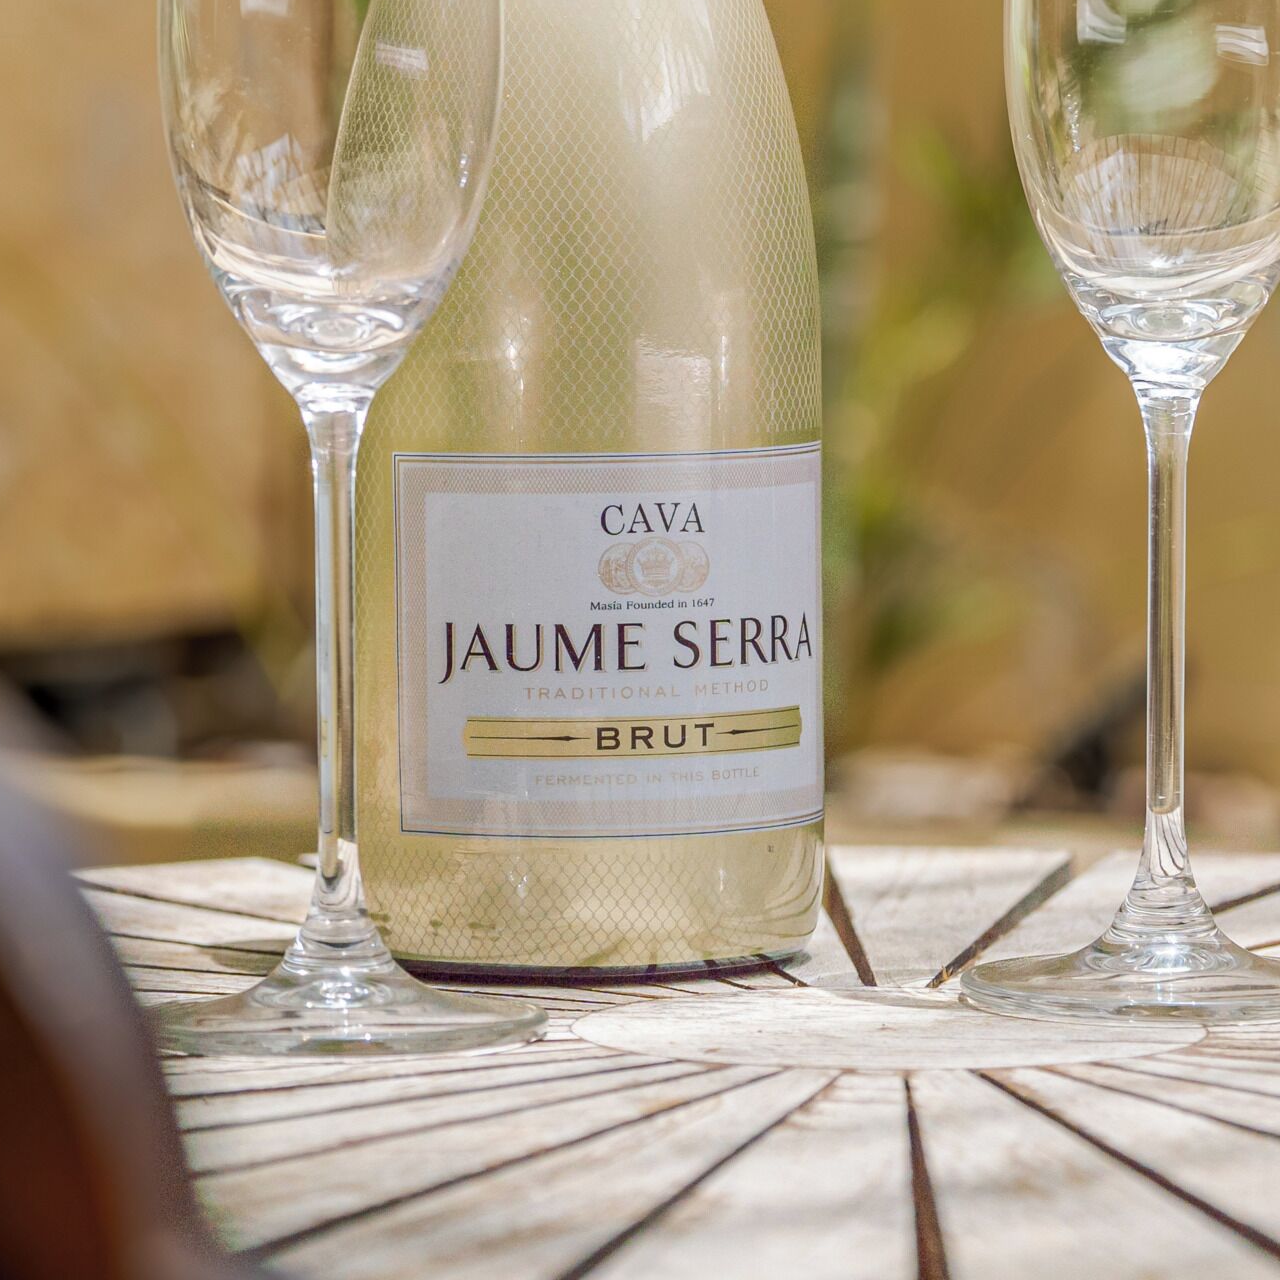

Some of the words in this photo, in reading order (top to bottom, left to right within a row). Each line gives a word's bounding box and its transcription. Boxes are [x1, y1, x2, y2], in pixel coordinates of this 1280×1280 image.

[600, 502, 706, 536] CAVA
[626, 599, 675, 610] Founded
[677, 599, 688, 609] in
[691, 597, 715, 608] 1647
[437, 621, 648, 685] JAUME
[672, 611, 813, 670] SERRA
[523, 685, 681, 701] TRADITIONAL
[694, 679, 769, 697] METHOD
[596, 722, 716, 751] BRUT
[535, 773, 638, 787] FERMENTED
[646, 772, 662, 785] IN
[671, 770, 704, 783] THIS
[711, 766, 760, 781] BOTTLE
